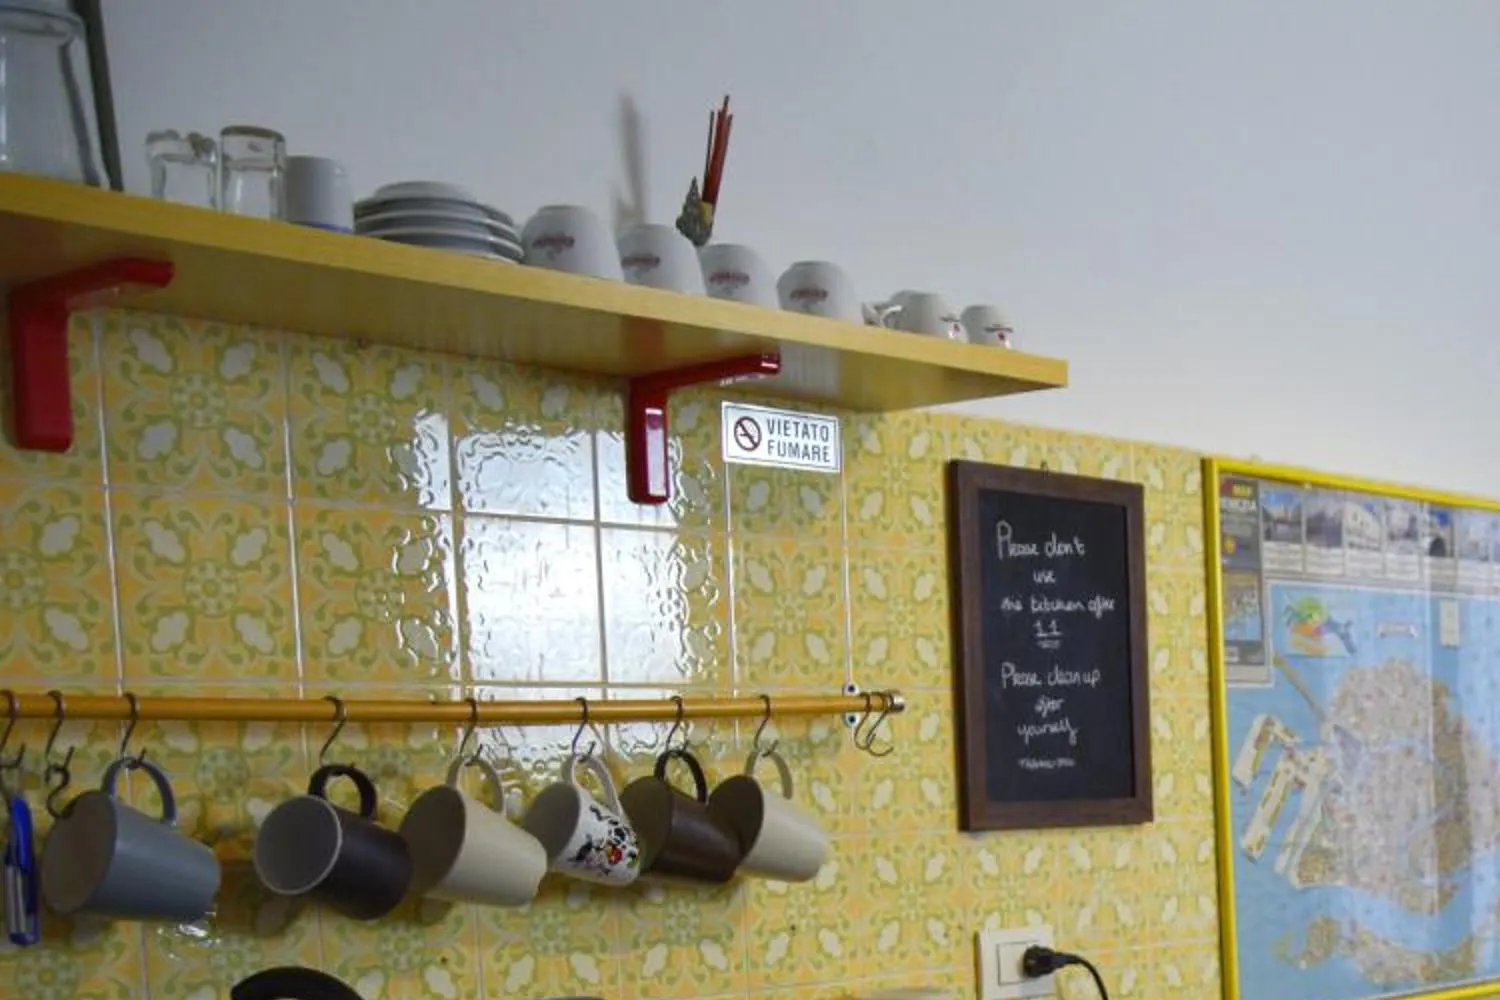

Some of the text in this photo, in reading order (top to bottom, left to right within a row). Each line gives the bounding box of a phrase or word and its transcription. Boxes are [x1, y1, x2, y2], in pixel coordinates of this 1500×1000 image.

[766, 418, 829, 442] VIETATO
[767, 440, 830, 462] FUMARE
[1033, 570, 1056, 584] use
